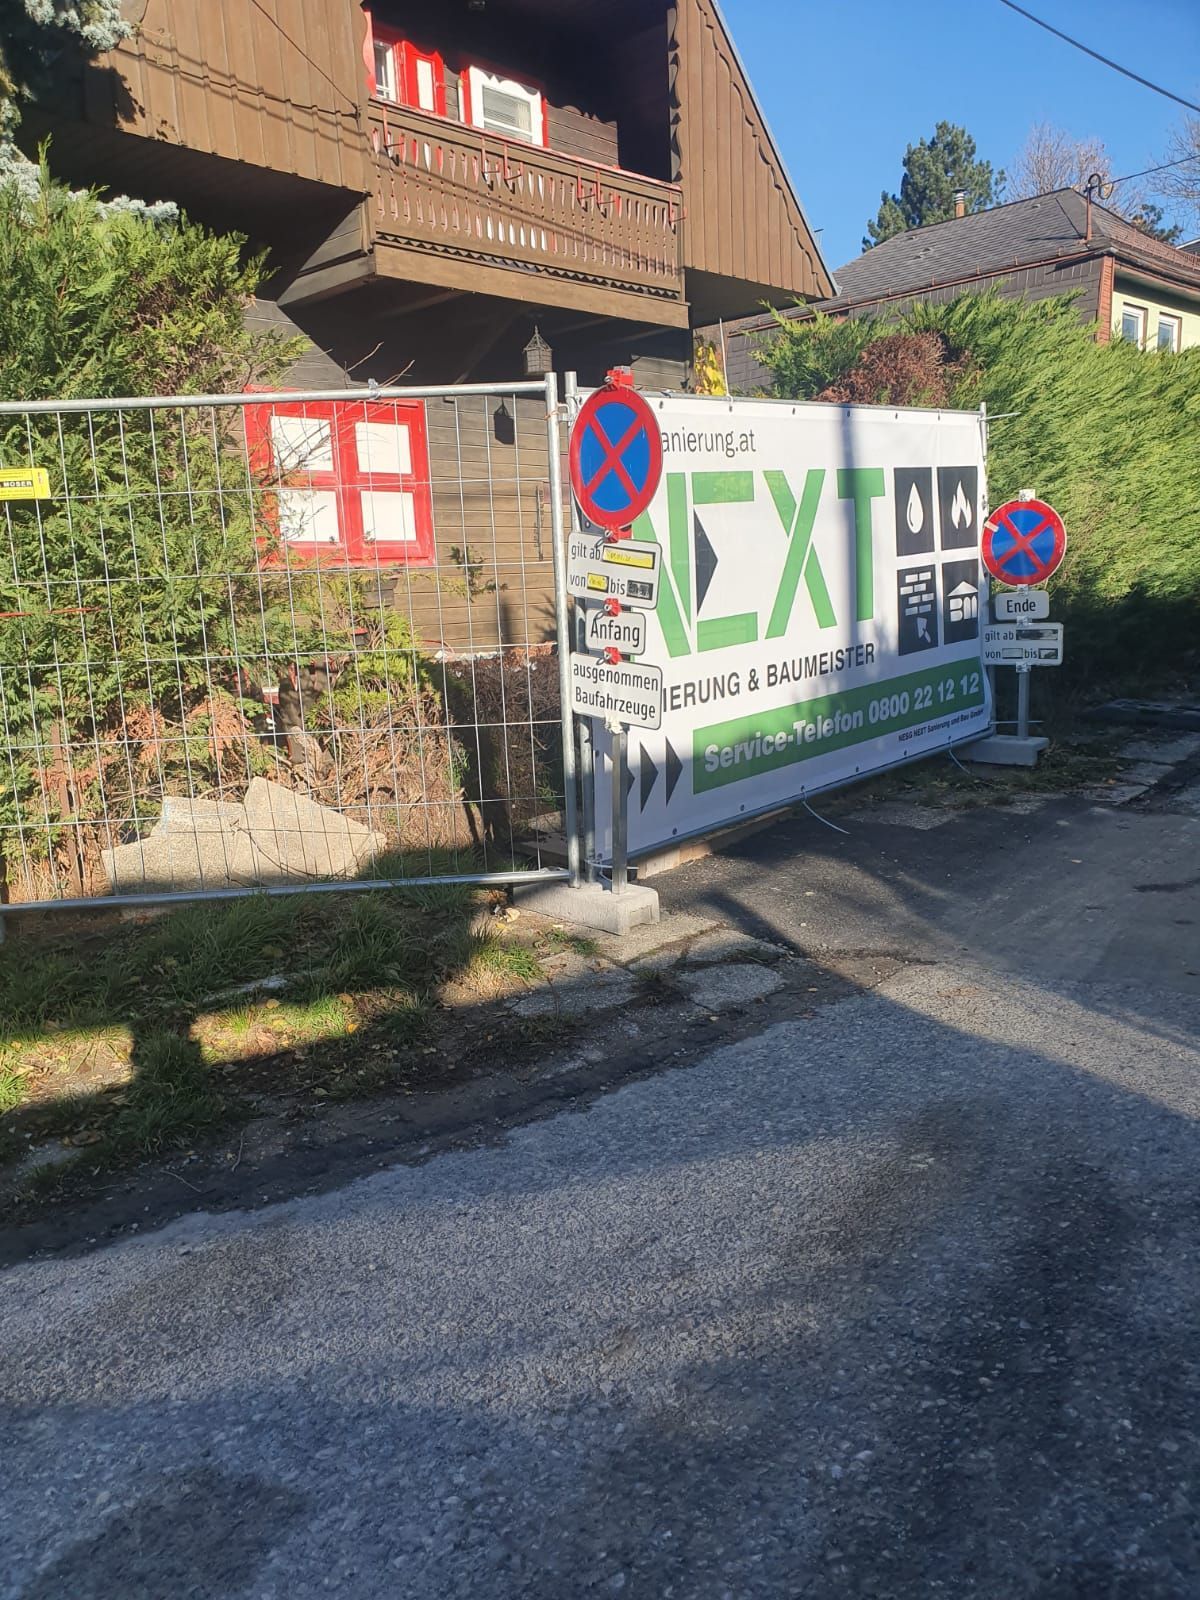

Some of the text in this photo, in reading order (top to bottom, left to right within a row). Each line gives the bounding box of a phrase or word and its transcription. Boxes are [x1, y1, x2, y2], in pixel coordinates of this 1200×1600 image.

[661, 426, 756, 458] anierung.at
[571, 542, 587, 560] gilt
[589, 545, 601, 561] ab
[631, 466, 886, 658] NEXT
[570, 574, 586, 588] von
[610, 578, 626, 595] bis
[1006, 599, 1036, 613] Ende
[590, 617, 640, 648] Anfang
[985, 629, 1014, 643] gilt ab
[985, 648, 1037, 659] von bis
[573, 662, 659, 692] ausgenommen
[663, 642, 875, 712] IERUNG & BAUMEISTER
[575, 686, 656, 721] Baufahrzeuge
[704, 672, 980, 773] Service-Telefon 0800 22 12 12
